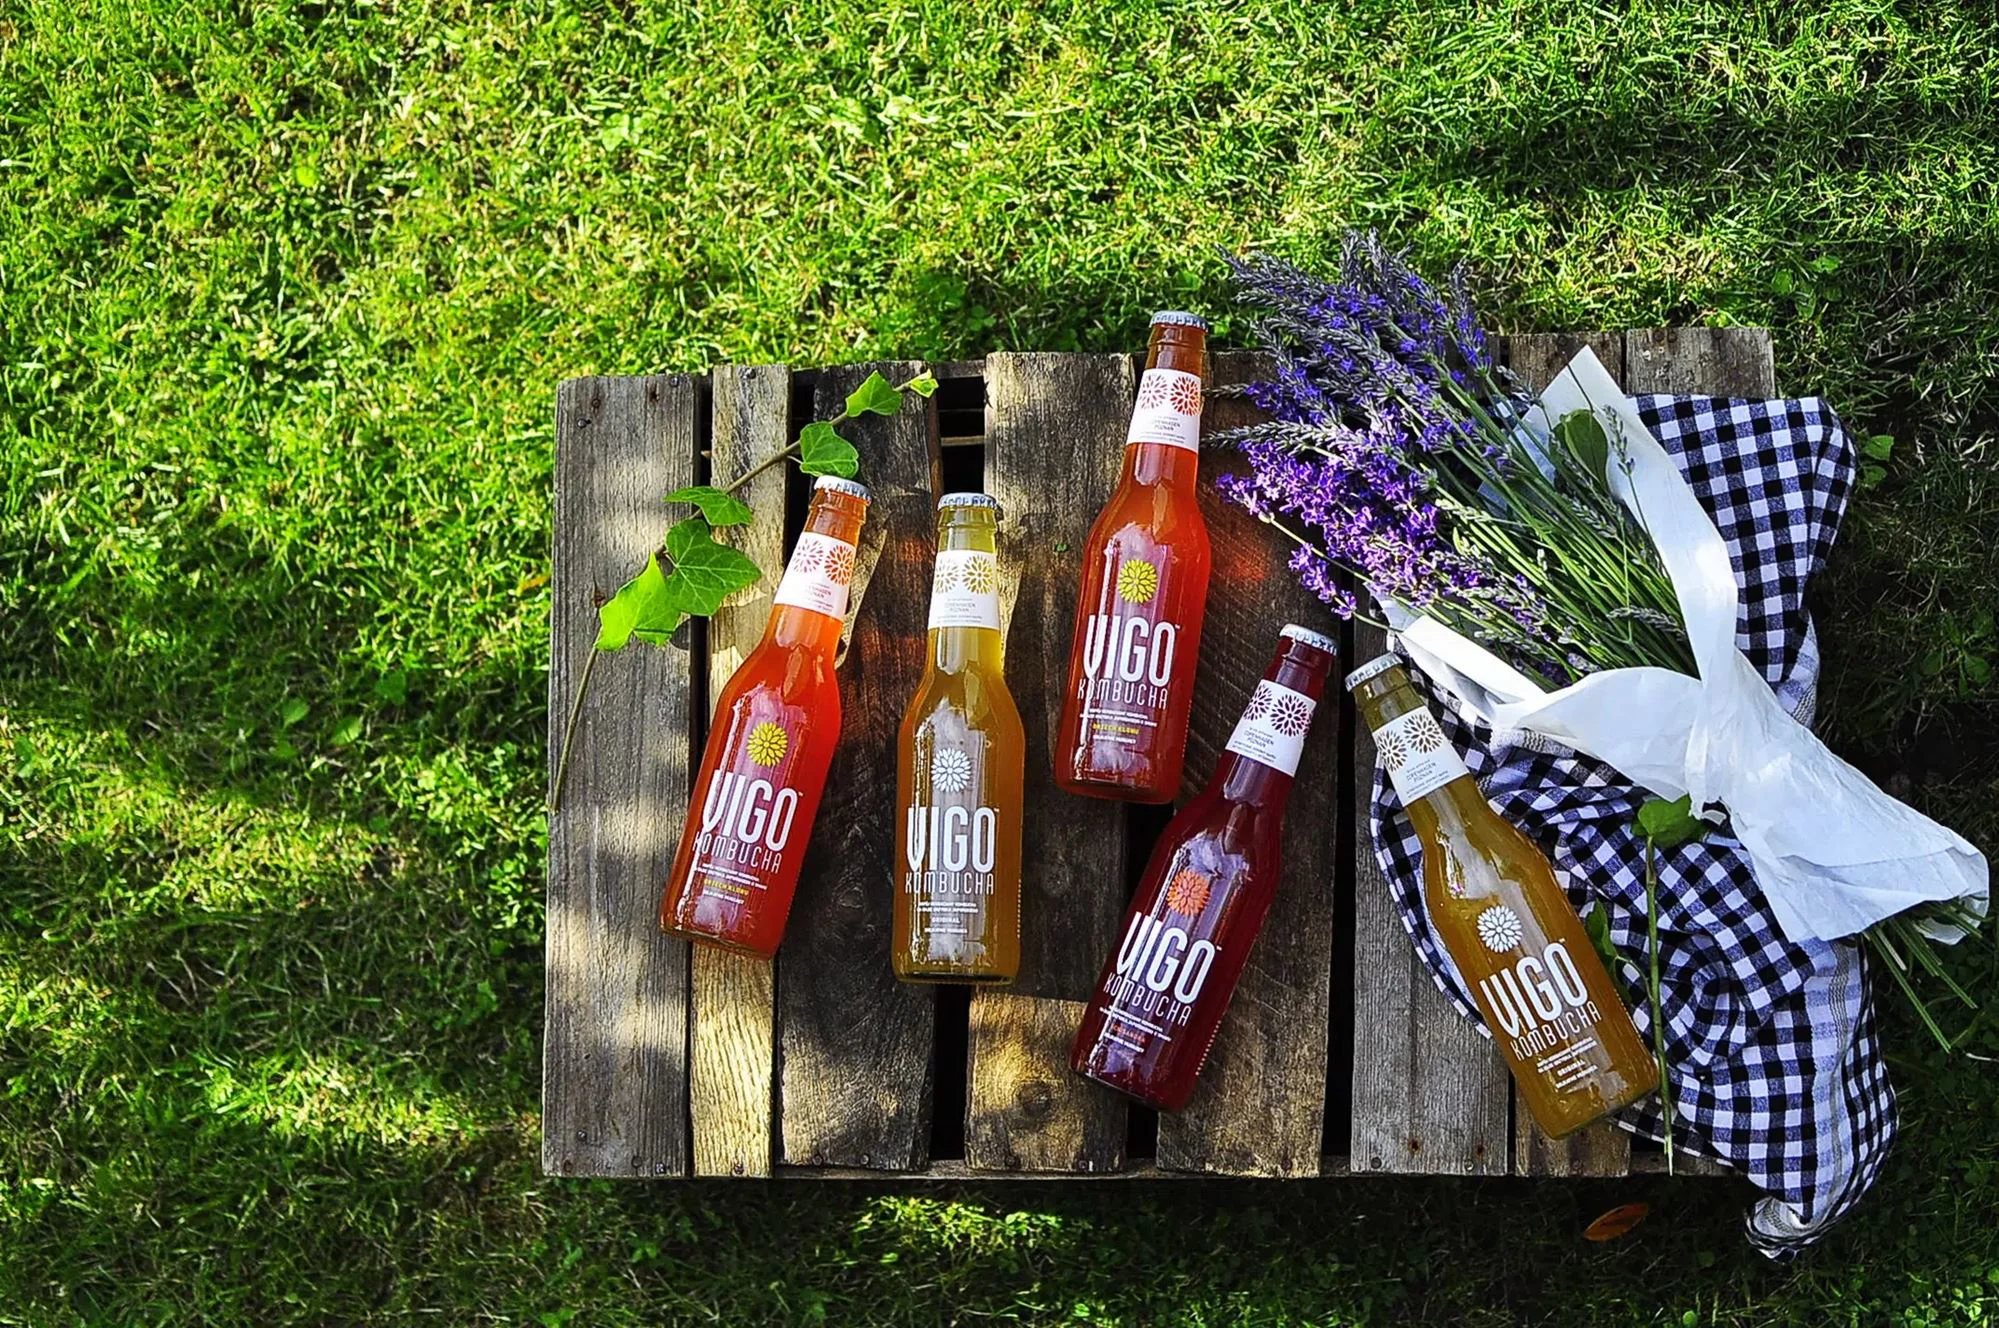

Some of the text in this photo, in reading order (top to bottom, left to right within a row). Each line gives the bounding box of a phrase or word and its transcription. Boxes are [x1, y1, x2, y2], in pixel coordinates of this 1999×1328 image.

[1083, 614, 1176, 687] VIGO
[1077, 679, 1169, 710] KOMBUCHA
[702, 769, 798, 851] VIGO
[907, 806, 996, 873] VIGO
[692, 831, 783, 873] KOMBUCHA
[905, 871, 994, 895] KOMBUCHA
[1116, 911, 1216, 1004] VIGO
[1103, 972, 1192, 1027] KOMBUCHA
[1479, 942, 1588, 1039] VIGO
[1510, 1001, 1602, 1061] KOMBUCHA
